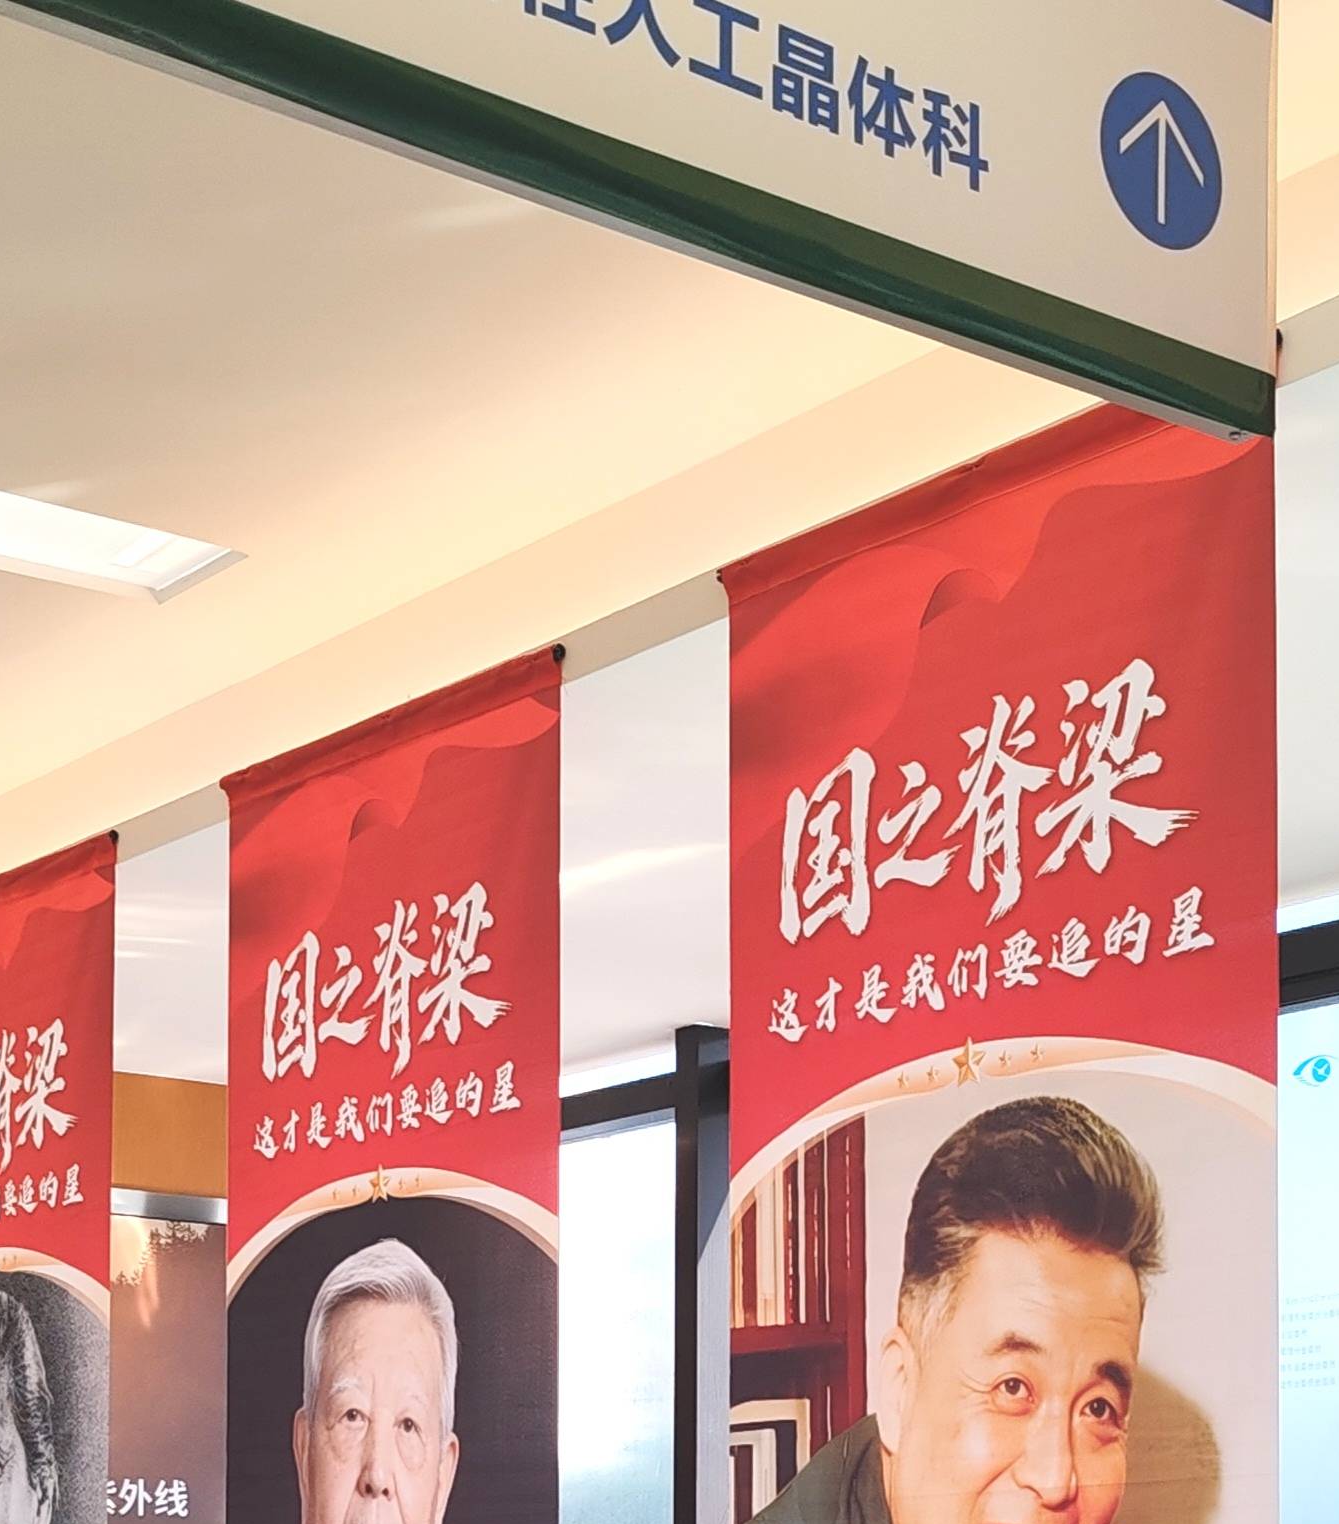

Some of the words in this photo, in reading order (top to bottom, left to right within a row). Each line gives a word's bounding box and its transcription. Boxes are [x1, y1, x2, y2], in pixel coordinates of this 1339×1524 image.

[778, 658, 1200, 944] 国之脊梁
[261, 881, 513, 1082] 国之脊梁
[768, 886, 1215, 1042] 这才是我们要追的星
[253, 1060, 522, 1159] 这才是我们要追的星
